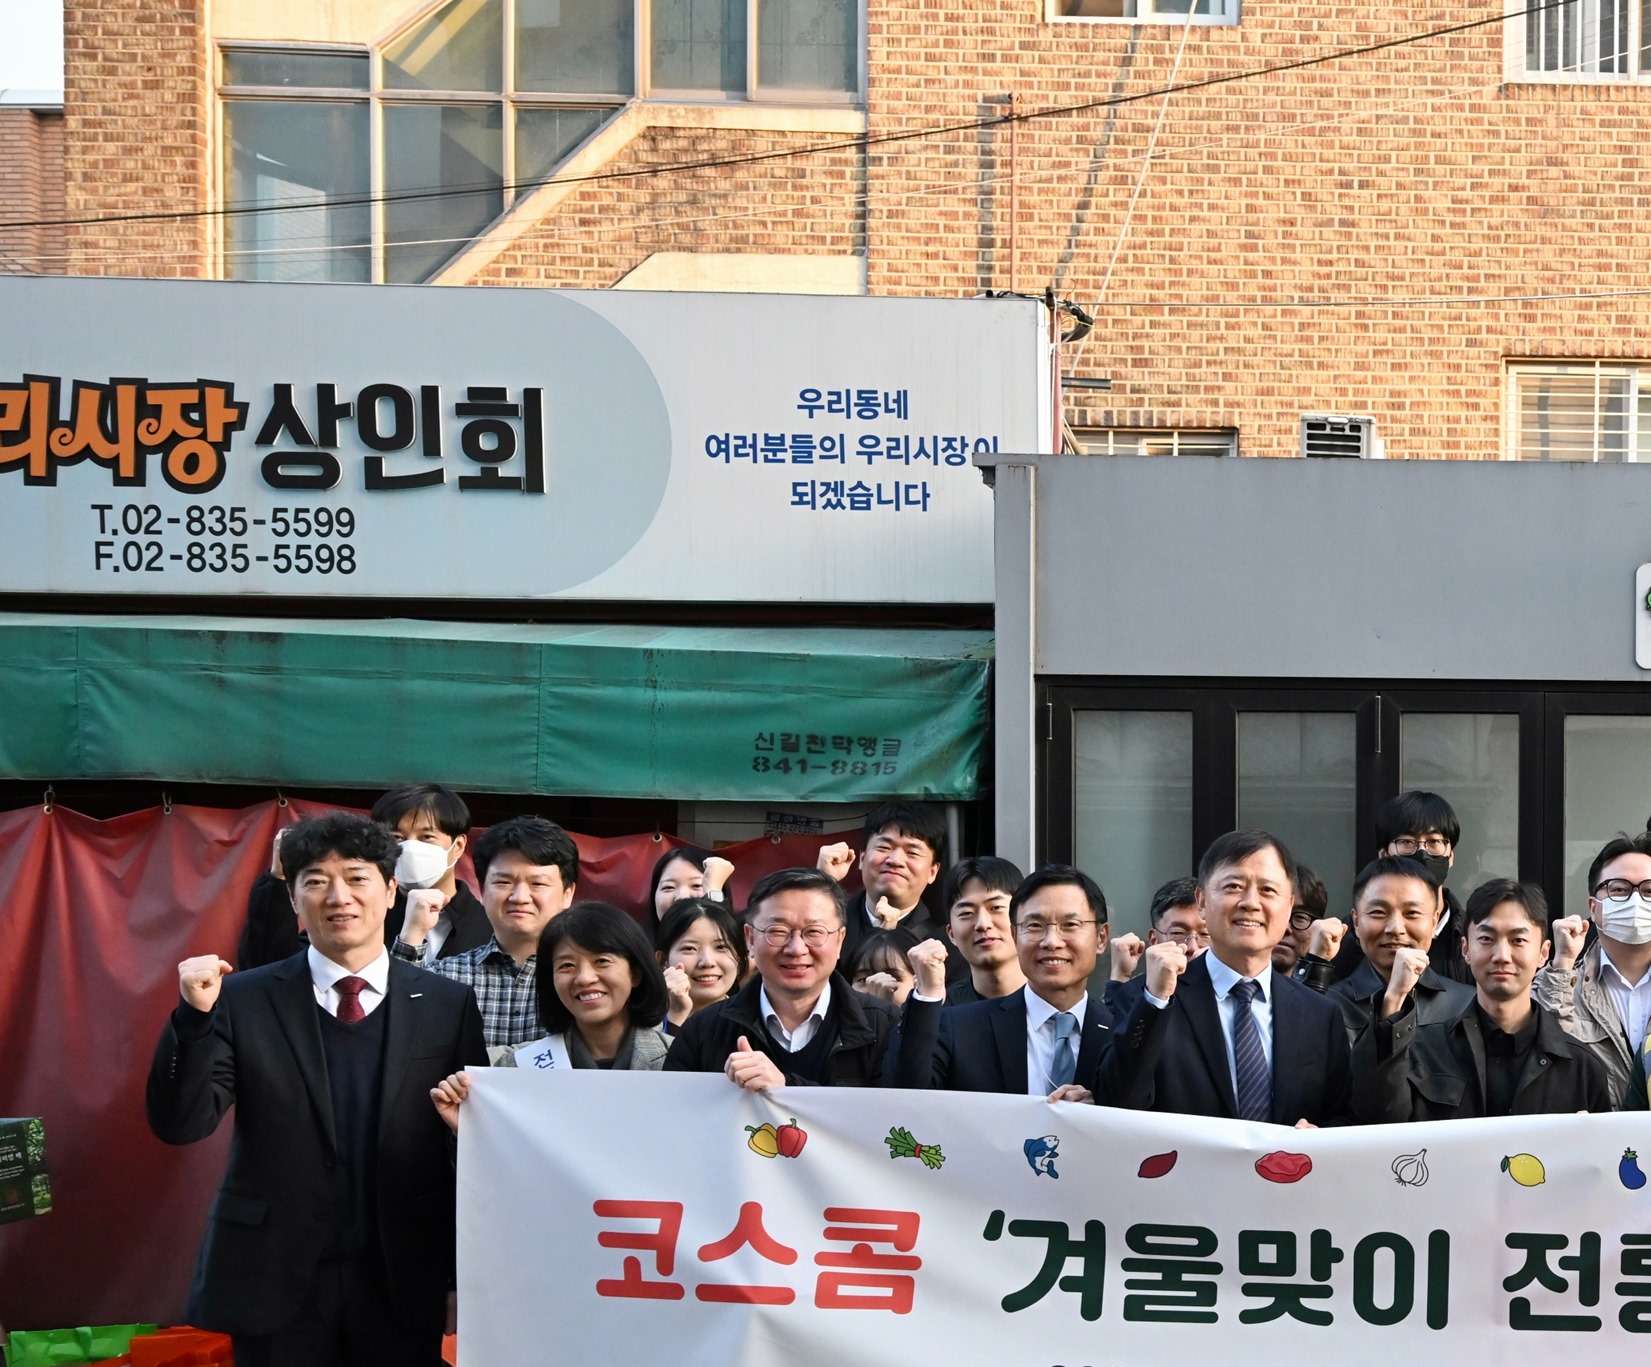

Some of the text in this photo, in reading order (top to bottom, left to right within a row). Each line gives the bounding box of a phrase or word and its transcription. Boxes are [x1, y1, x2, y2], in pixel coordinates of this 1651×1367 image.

[796, 388, 909, 420] 우리동네
[255, 383, 546, 494] 상인회
[705, 433, 999, 467] 여러분들의 우리시장이
[790, 480, 931, 512] 되겠습니다
[91, 503, 356, 538] T.02-835-5599
[94, 540, 357, 574] F.02-835-5598
[752, 756, 898, 776] 841-8815
[592, 1198, 922, 1316] 코스콤
